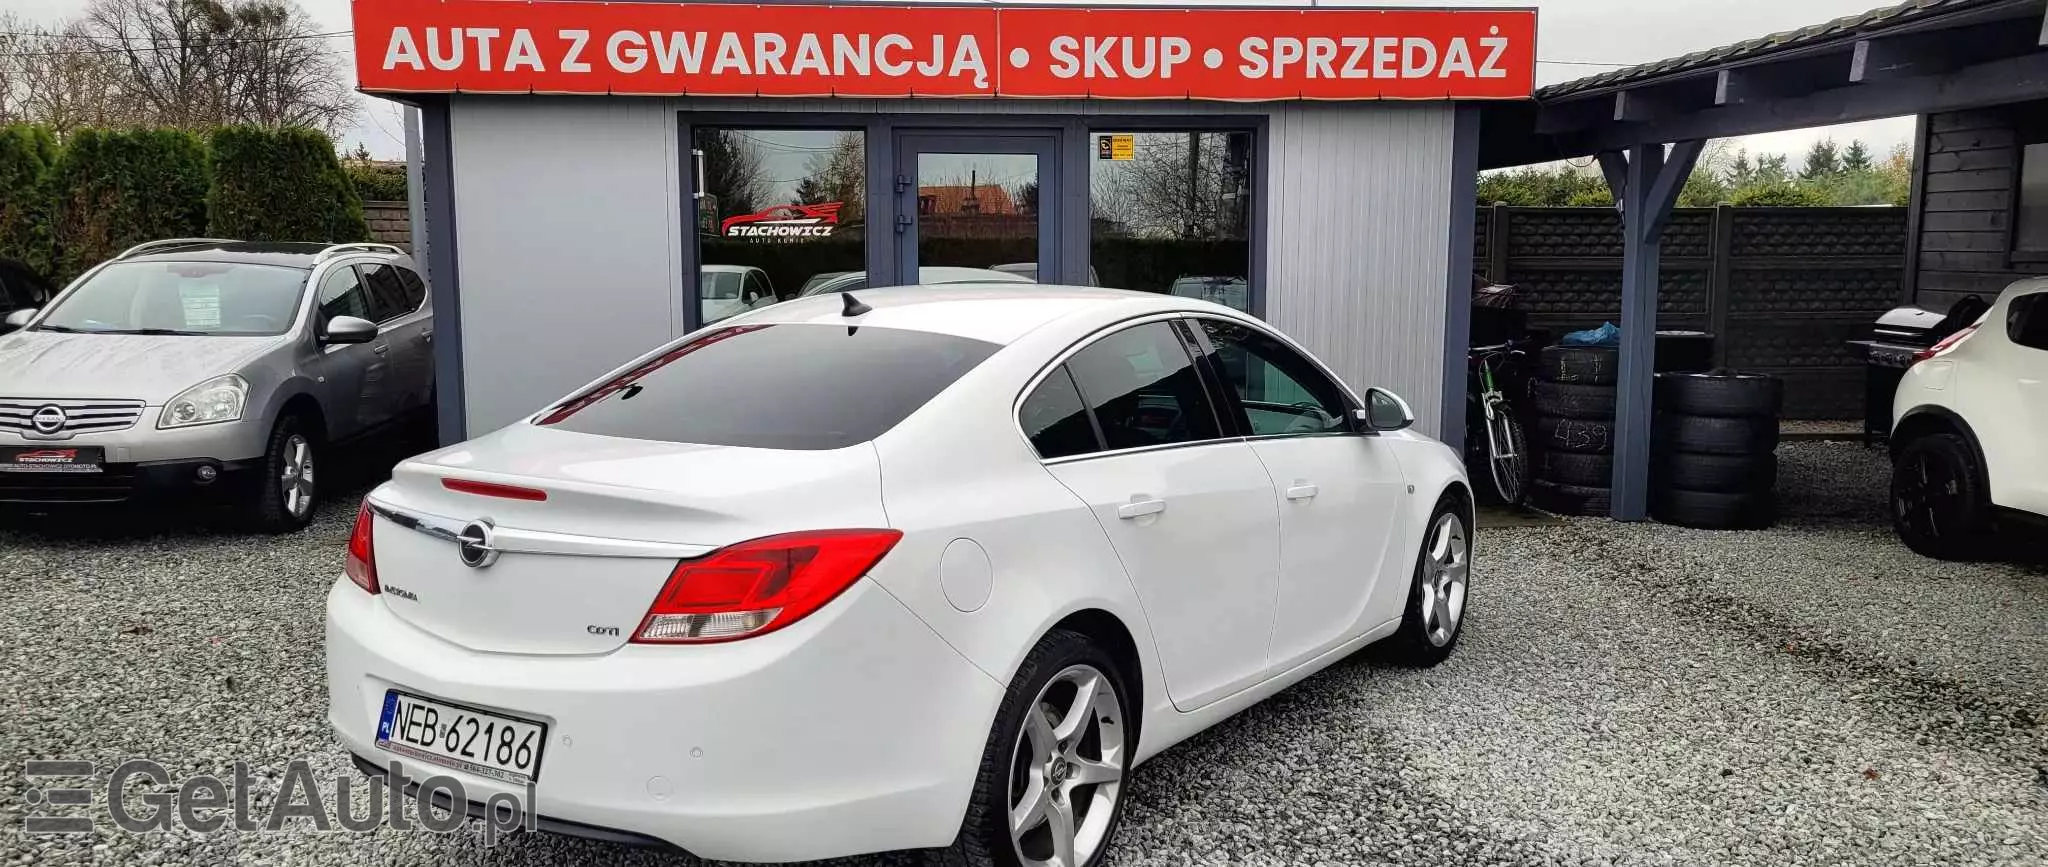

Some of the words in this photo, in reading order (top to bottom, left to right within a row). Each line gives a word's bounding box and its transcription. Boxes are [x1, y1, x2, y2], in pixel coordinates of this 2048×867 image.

[382, 26, 546, 72] AUTA
[560, 29, 592, 72] Z
[606, 31, 989, 88] GWARANCJĄ
[1049, 36, 1192, 79] SKUP
[1238, 26, 1509, 79] SPRZEDAŻ
[727, 225, 834, 237] STACHOWICZ
[381, 721, 390, 734] PL
[391, 700, 439, 747] NEB
[445, 715, 536, 770] 62186
